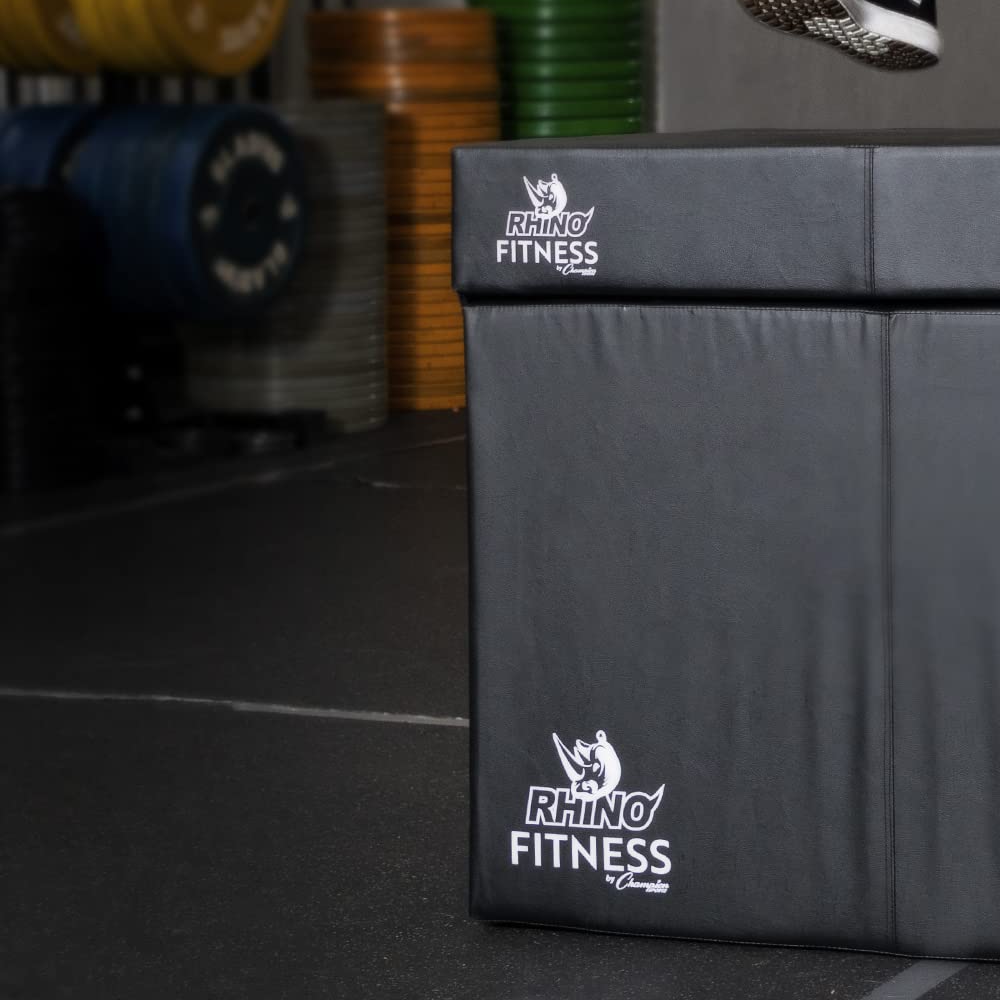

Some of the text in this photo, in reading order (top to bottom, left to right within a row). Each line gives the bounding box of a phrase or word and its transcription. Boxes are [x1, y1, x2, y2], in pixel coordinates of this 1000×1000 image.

[505, 206, 595, 237] RHINO
[496, 239, 599, 265] FITNESS
[525, 783, 666, 832] RHINO
[510, 830, 673, 875] FITNESS
[605, 873, 616, 885] by
[615, 871, 670, 893] Champion
